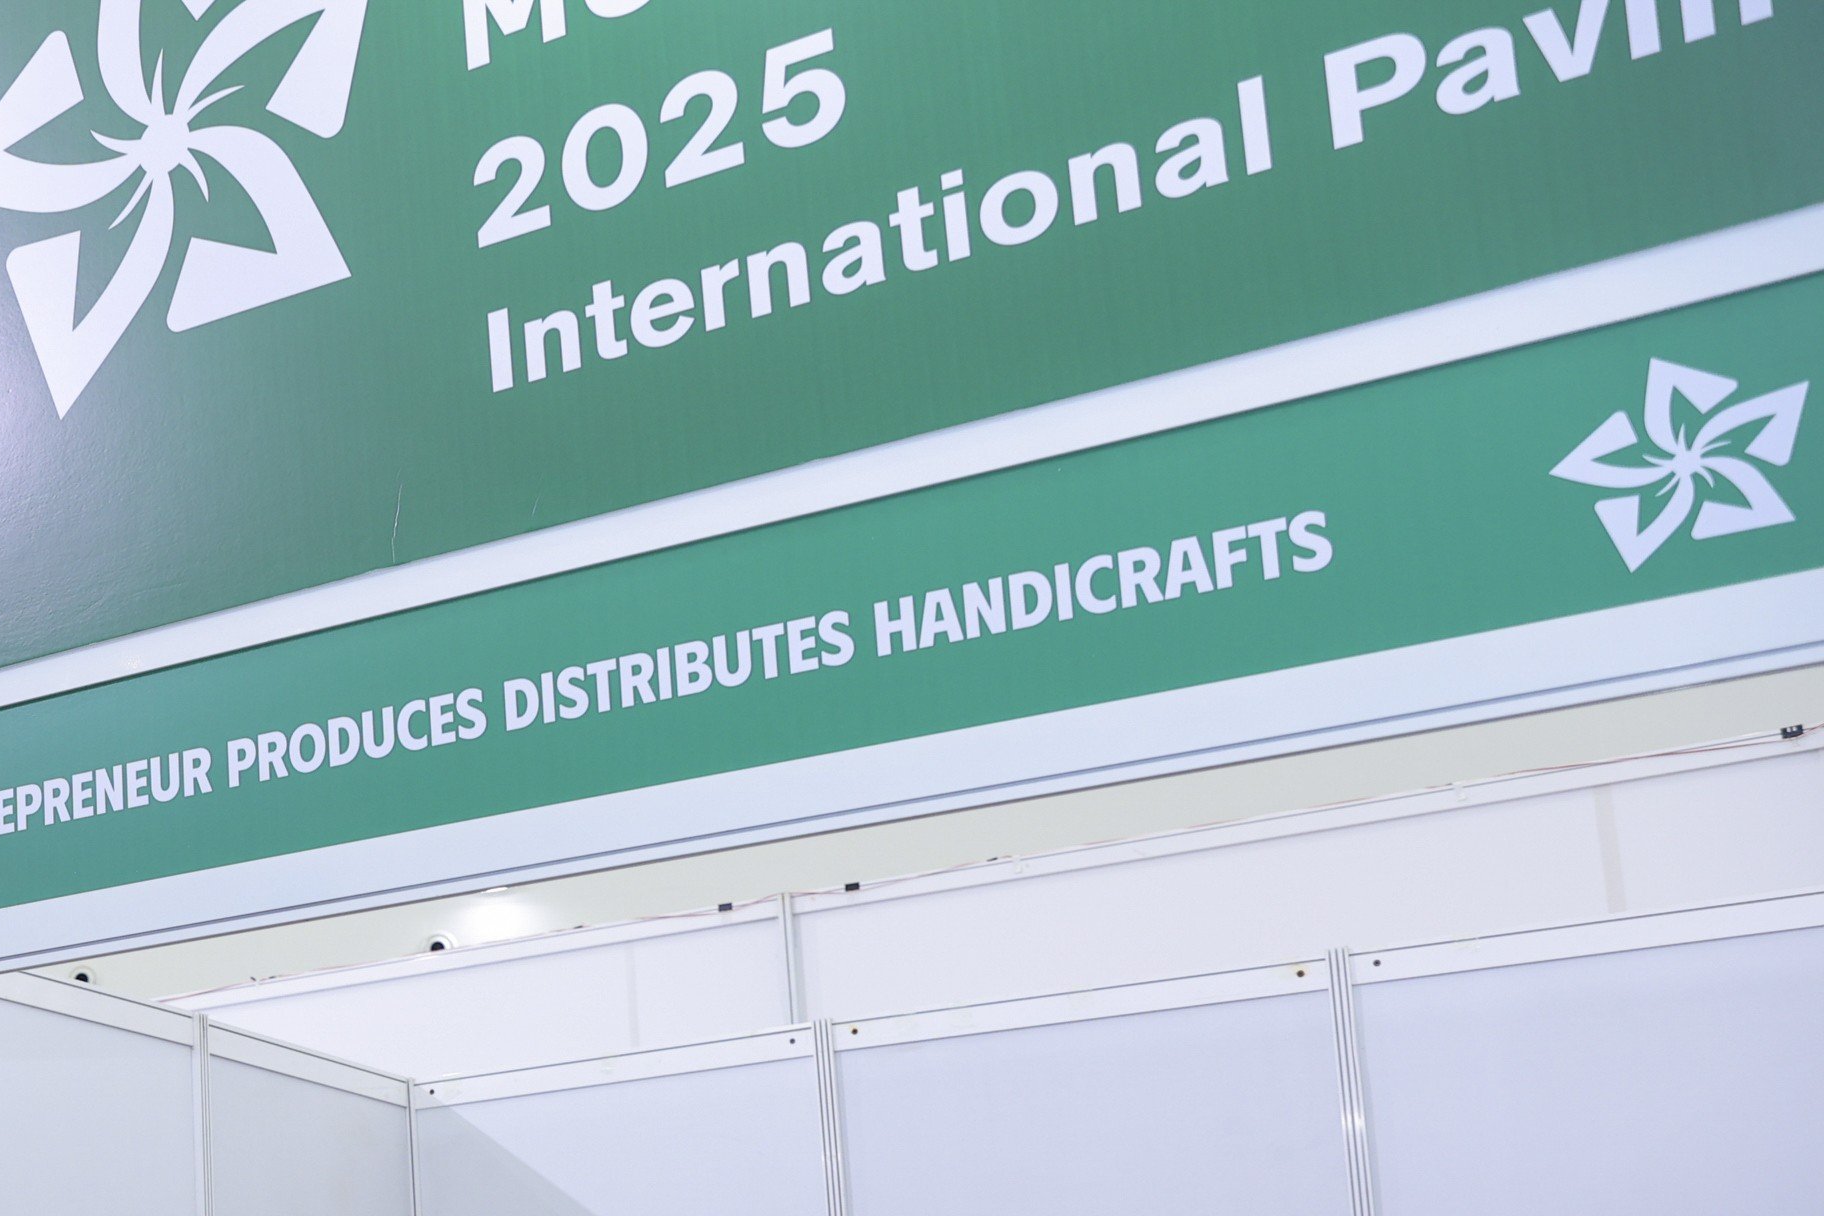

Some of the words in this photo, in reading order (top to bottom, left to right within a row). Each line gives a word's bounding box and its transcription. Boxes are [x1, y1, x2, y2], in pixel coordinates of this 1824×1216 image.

[473, 27, 846, 249] 2025
[486, 74, 1274, 394] International
[227, 687, 487, 789] PRODUCES
[505, 608, 855, 733] DISTRIBUTES
[873, 509, 1334, 660] HANDICRAFTS
